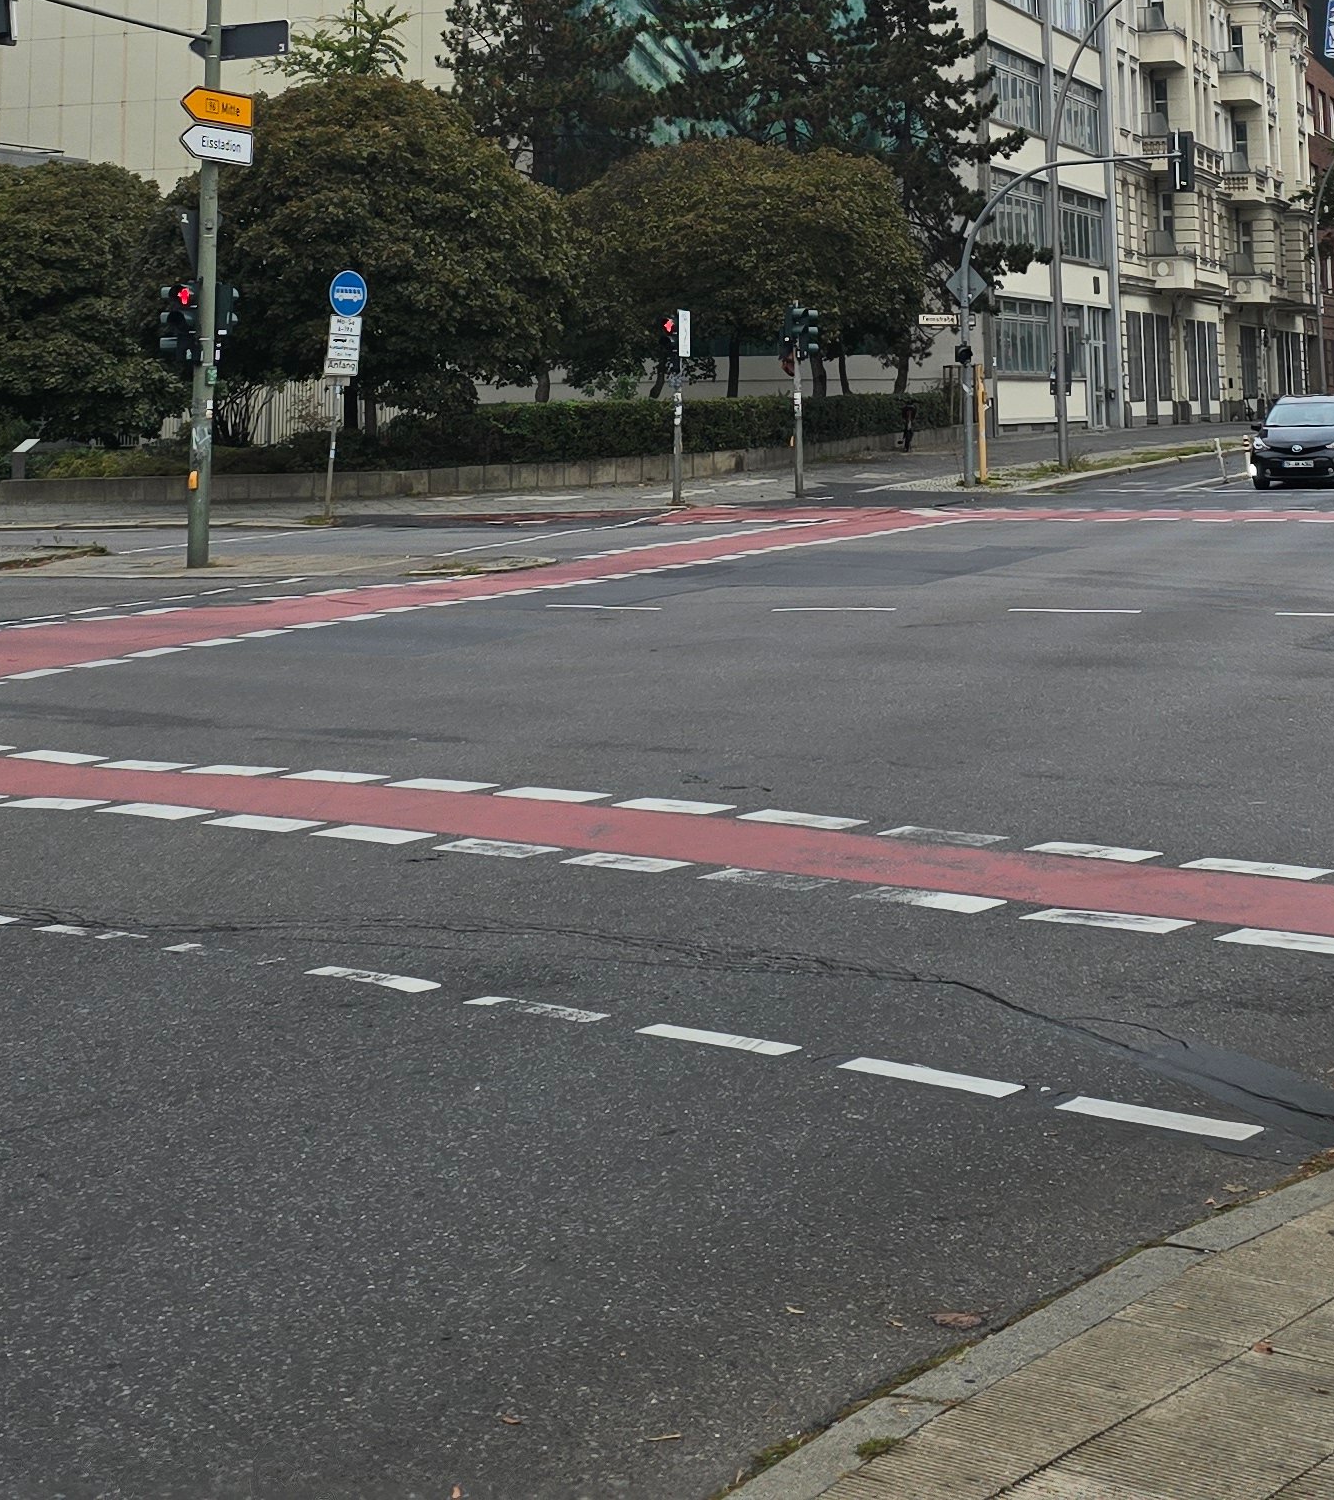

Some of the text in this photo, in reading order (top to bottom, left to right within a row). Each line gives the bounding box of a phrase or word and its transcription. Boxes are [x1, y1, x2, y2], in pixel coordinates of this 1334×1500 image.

[222, 102, 241, 117] Mitte
[201, 135, 242, 153] Eisstadion
[327, 361, 356, 371] Anfang
